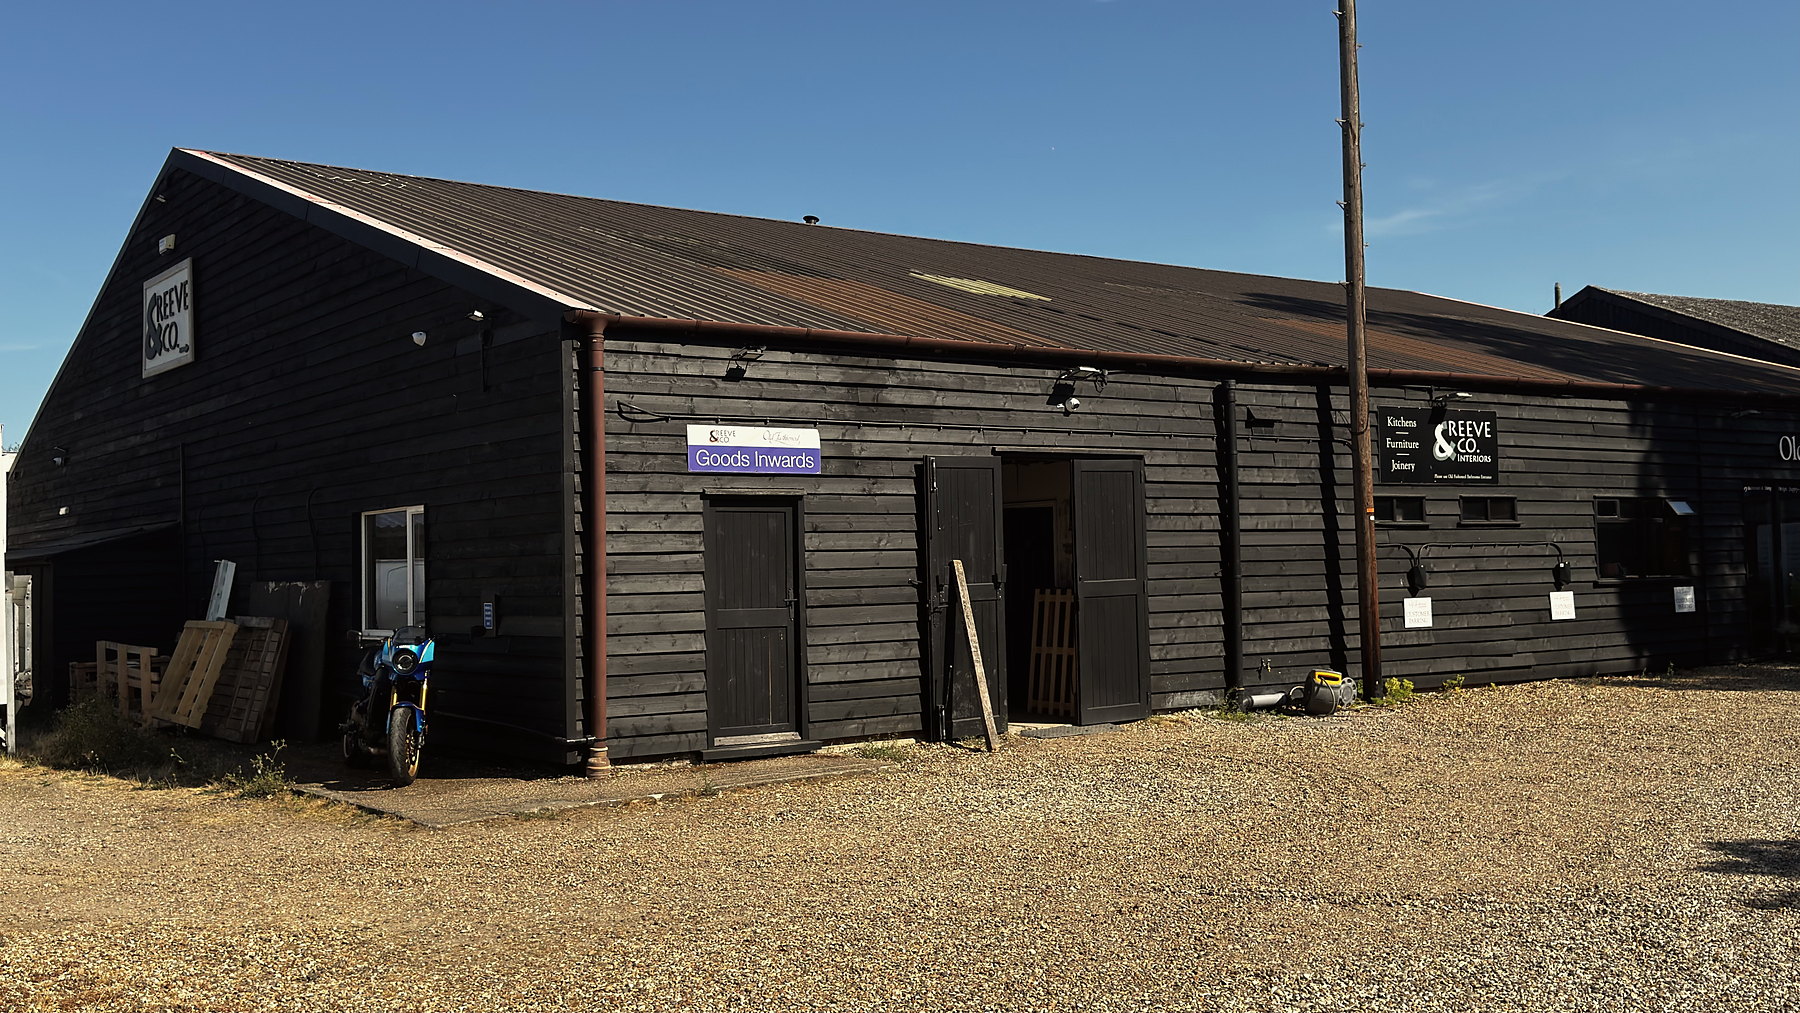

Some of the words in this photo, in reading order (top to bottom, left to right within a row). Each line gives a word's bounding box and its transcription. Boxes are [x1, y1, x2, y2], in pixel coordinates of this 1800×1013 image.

[156, 280, 189, 322] REEVE
[145, 293, 162, 360] &
[1387, 416, 1417, 428] Kitchens
[1448, 420, 1492, 438] REEVE
[715, 429, 736, 437] REEVE
[1386, 438, 1419, 449] Furniture
[1433, 421, 1457, 461] &
[1457, 438, 1480, 453] CO.
[695, 449, 750, 467] Goods
[754, 450, 815, 469] Inwards
[1391, 459, 1416, 472] Joinery
[1457, 454, 1492, 463] INTERIORS
